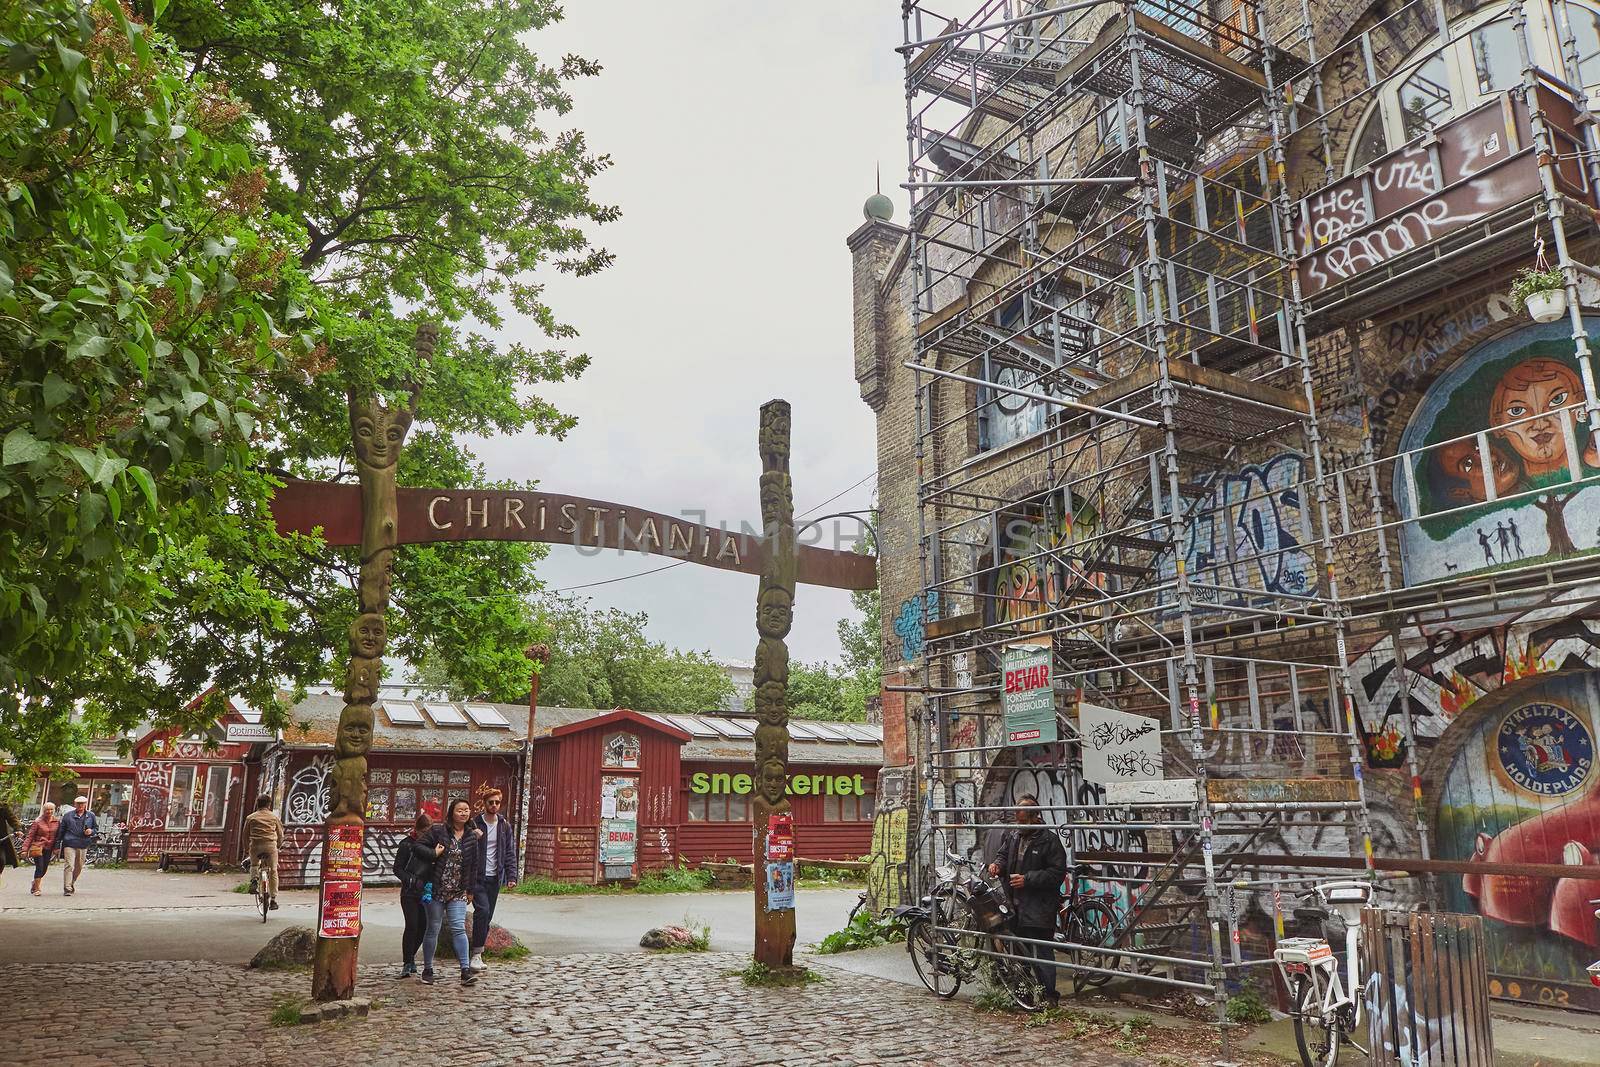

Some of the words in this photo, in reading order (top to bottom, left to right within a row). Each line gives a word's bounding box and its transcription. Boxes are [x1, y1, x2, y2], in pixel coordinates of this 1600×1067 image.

[1005, 665, 1050, 694] BEVAR
[1007, 698, 1050, 713] FORBEHOLDET
[1502, 704, 1579, 736] CYKELTAXI
[690, 771, 866, 796] sneeriet
[1504, 757, 1592, 794] HOLDEPLADS
[609, 831, 634, 842] BEVAR
